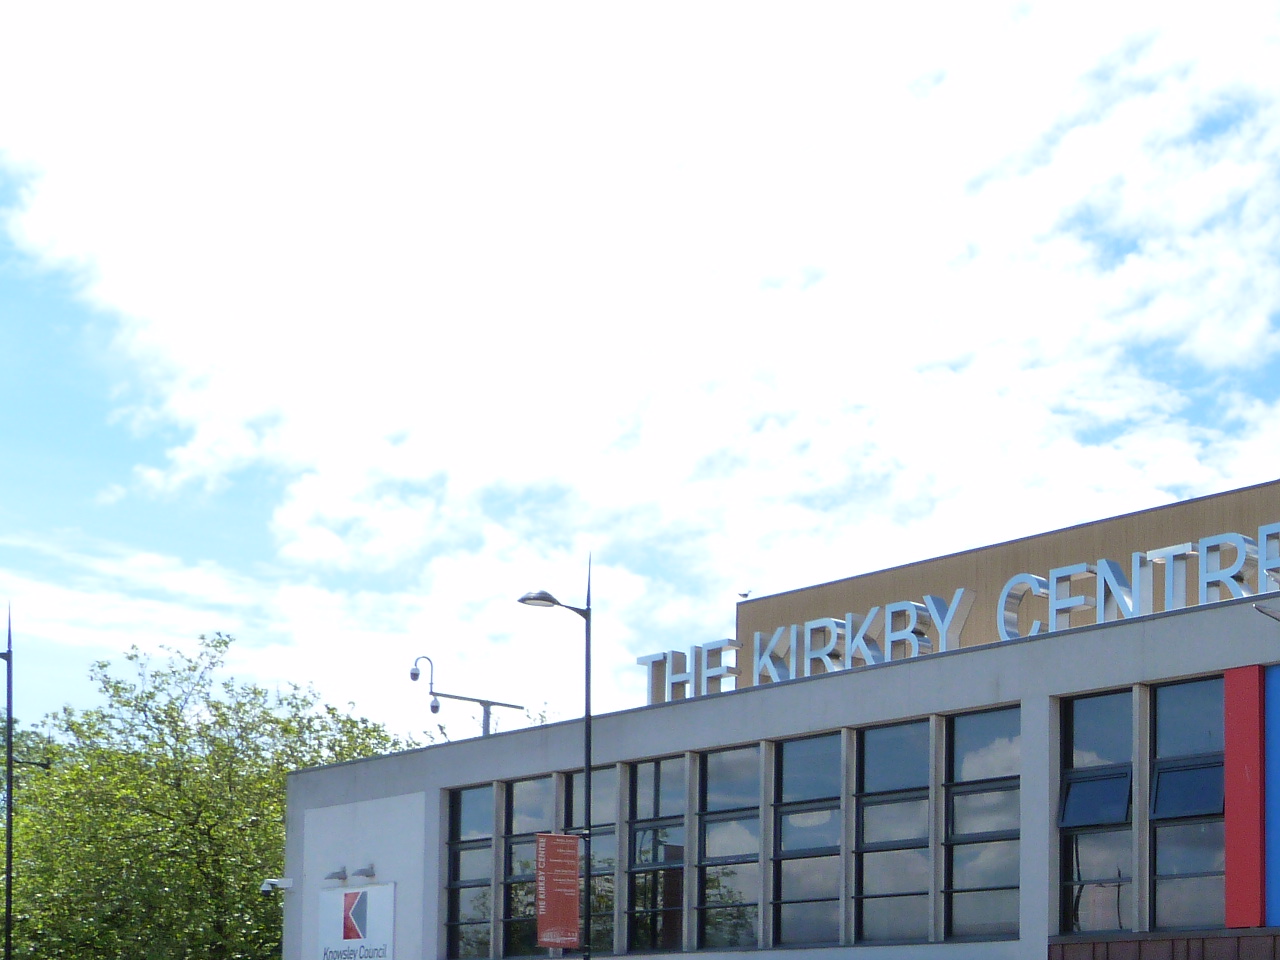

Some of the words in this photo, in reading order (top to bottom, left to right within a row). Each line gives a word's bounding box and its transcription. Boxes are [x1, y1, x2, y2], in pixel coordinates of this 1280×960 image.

[637, 639, 742, 705] THE
[753, 588, 972, 687] KIRKBY
[538, 838, 546, 869] CENTRE
[538, 871, 546, 899] KIRKBY
[538, 901, 546, 915] THE
[359, 944, 387, 959] Council
